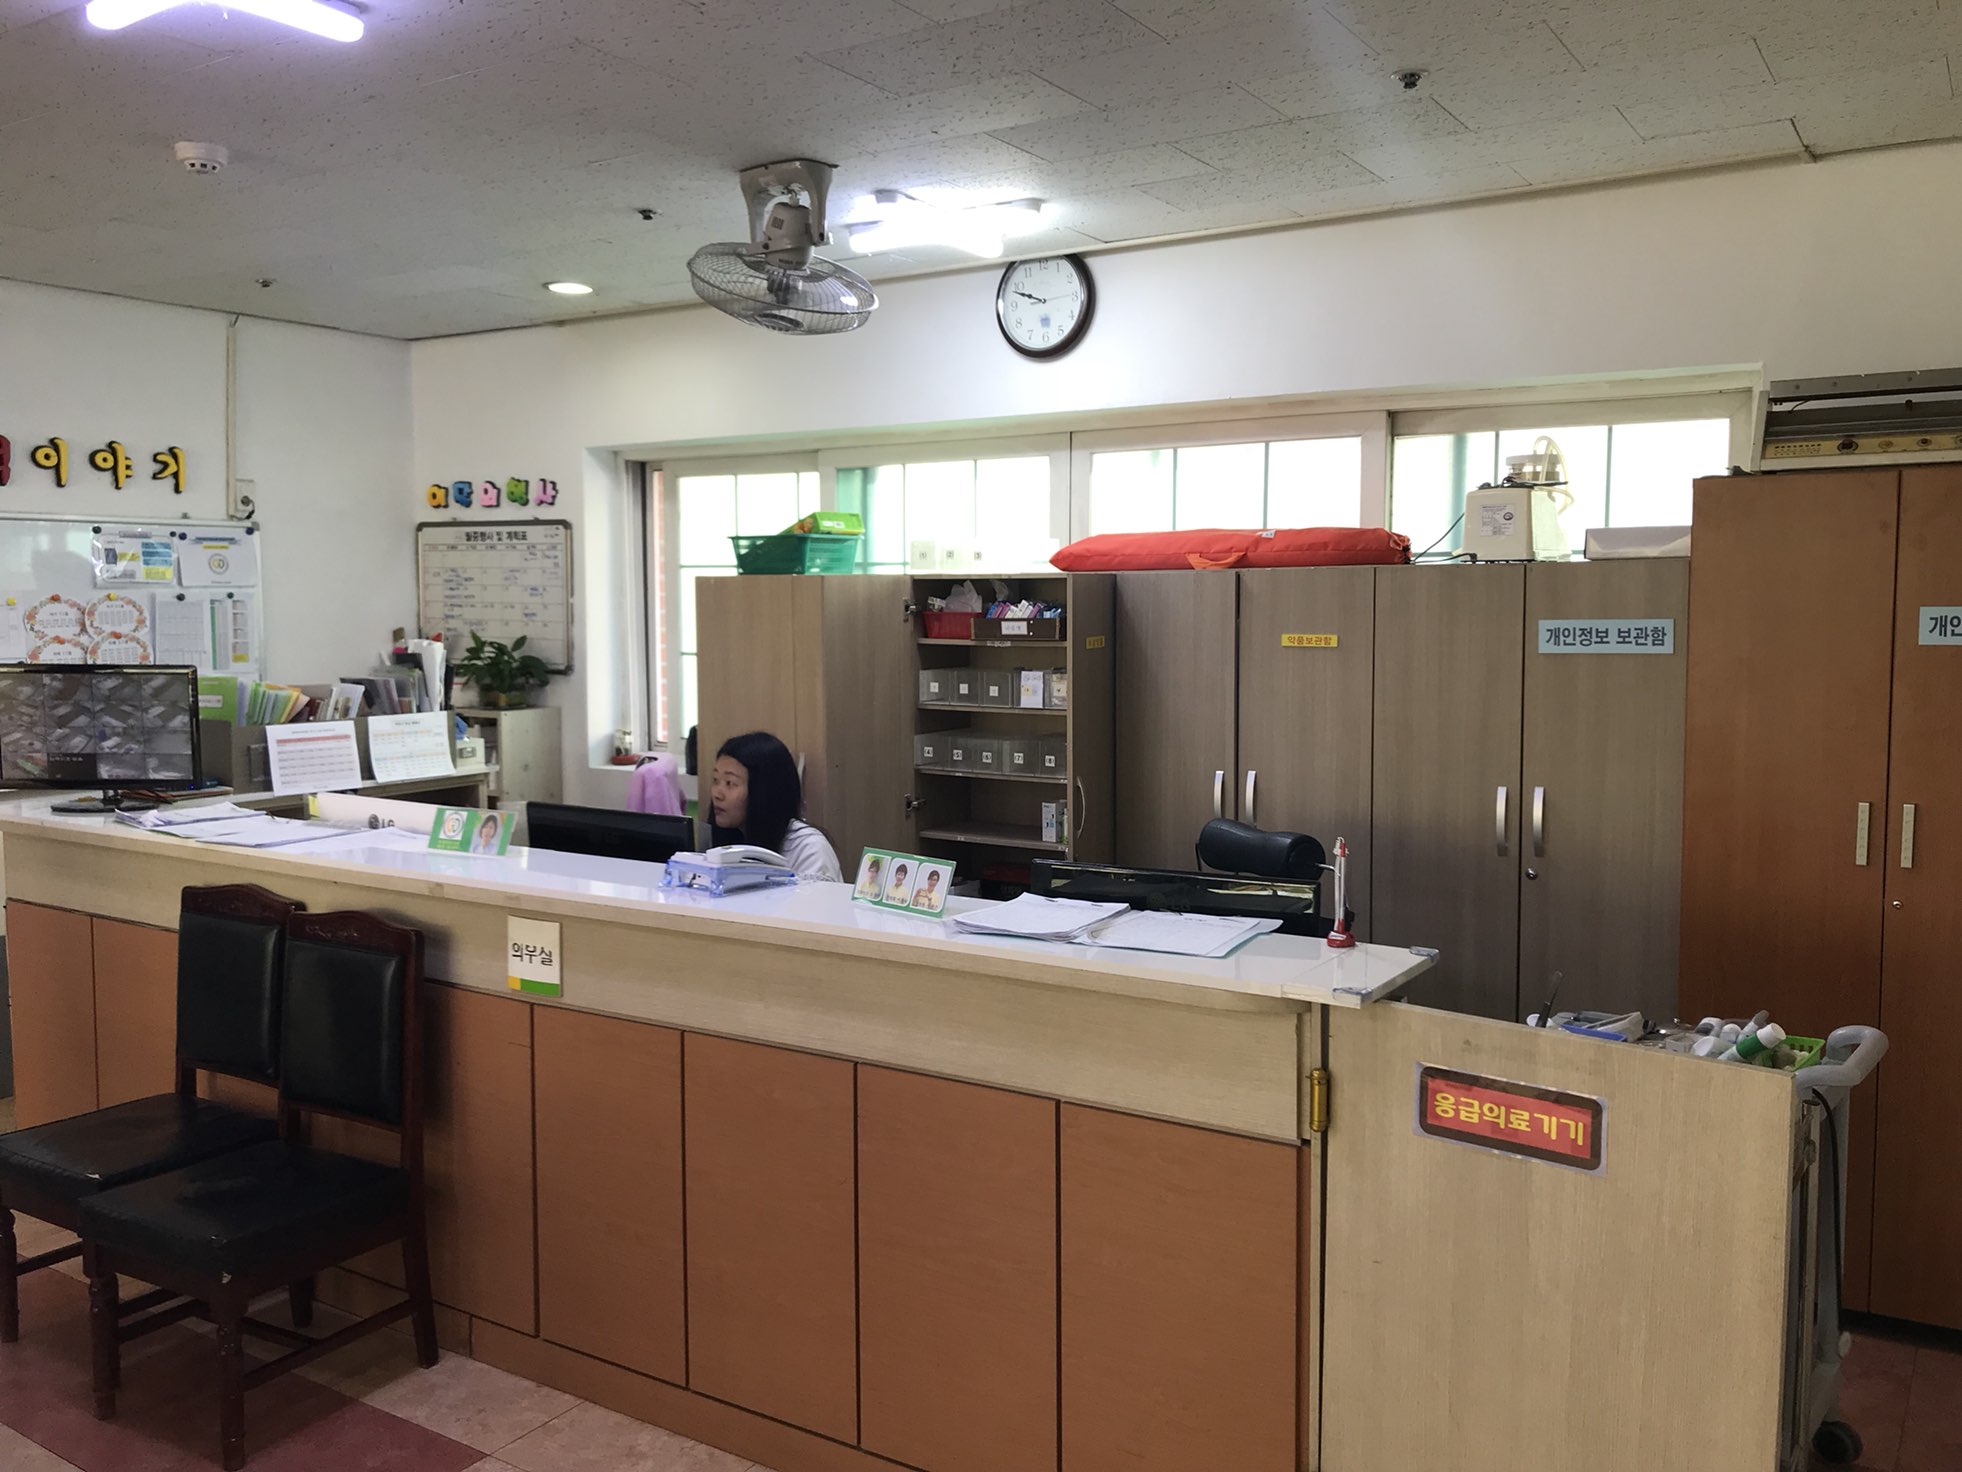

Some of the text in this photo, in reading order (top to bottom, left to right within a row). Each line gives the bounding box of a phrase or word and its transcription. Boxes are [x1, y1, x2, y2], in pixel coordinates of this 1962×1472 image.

[1024, 267, 1033, 278] 11
[1056, 262, 1061, 272] 1
[1067, 273, 1073, 284] 2
[1014, 282, 1025, 291] 10
[1072, 292, 1079, 302] 3
[1010, 301, 1018, 312] 9
[1068, 310, 1076, 321] 4
[1015, 318, 1023, 329] 8
[1027, 329, 1034, 341] 7
[1057, 325, 1065, 337] 5
[1042, 332, 1050, 343] 6
[1287, 635, 1332, 646] 약품보관함
[1546, 626, 1667, 647] 개인정보 보관함
[511, 942, 553, 966] 의무실
[1433, 1092, 1585, 1146] 응급의료기기
